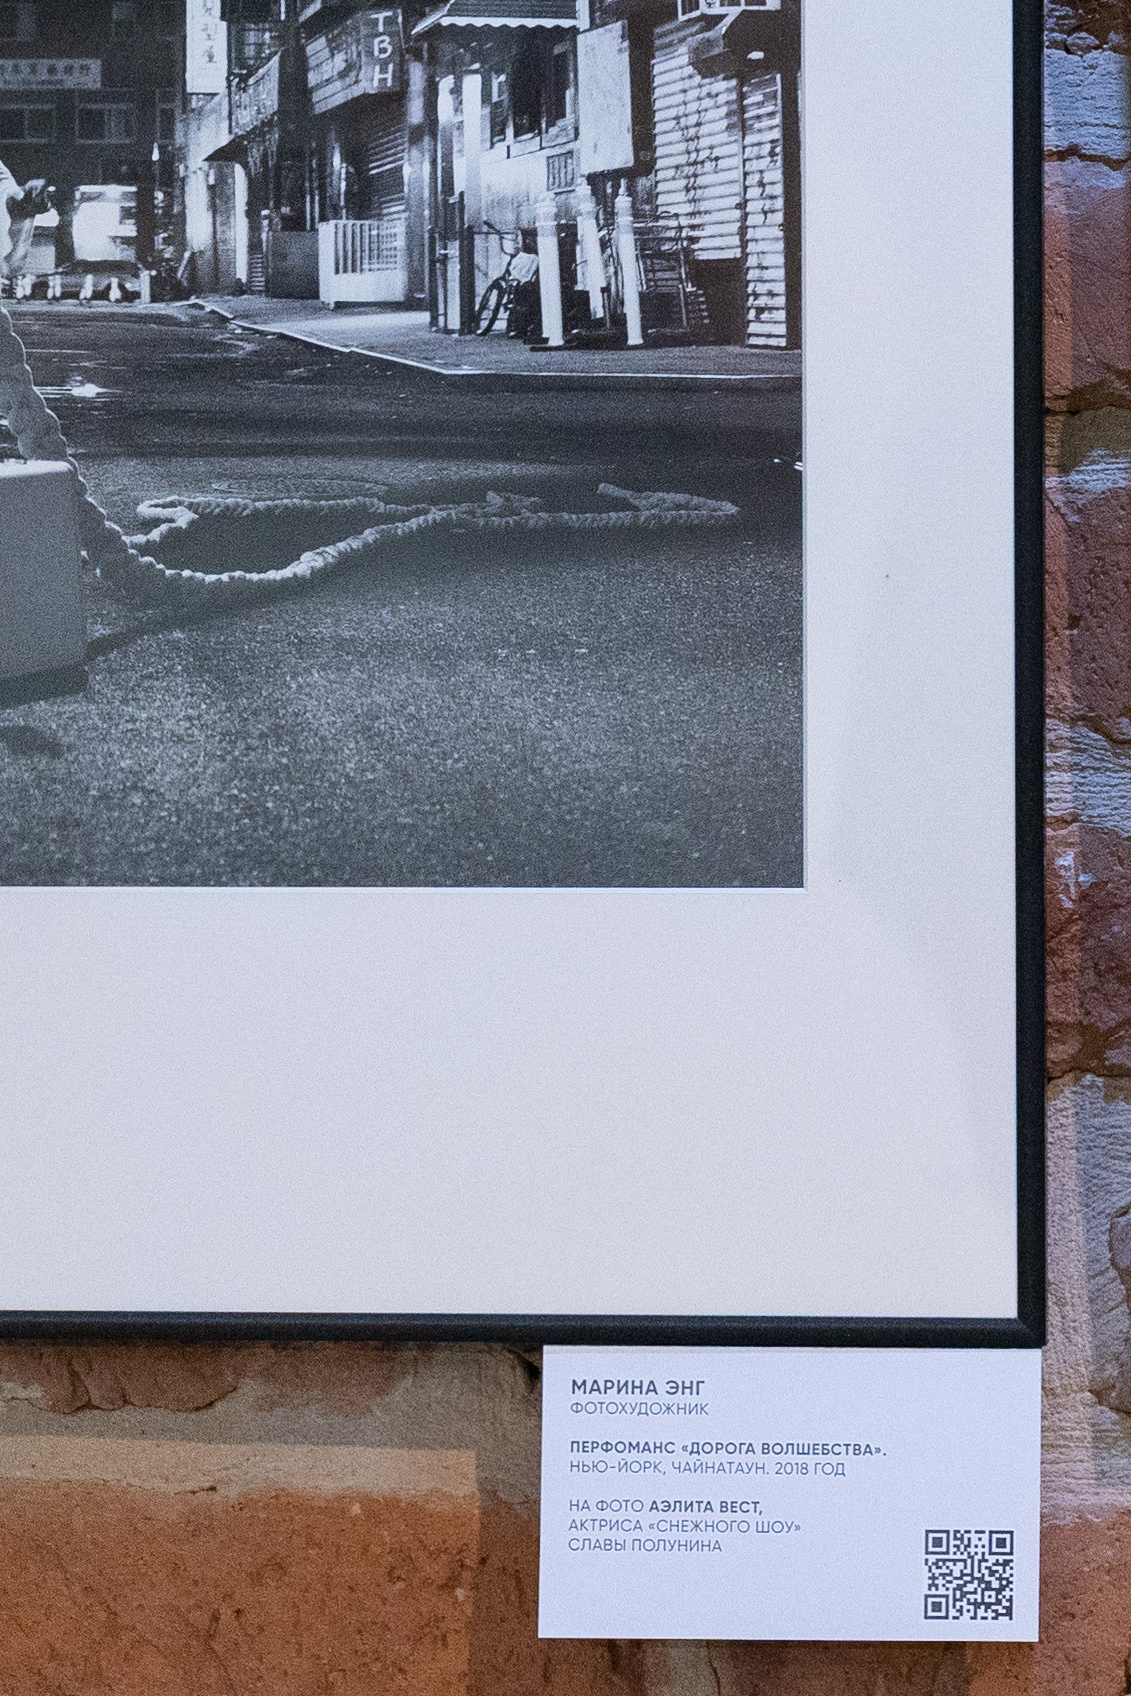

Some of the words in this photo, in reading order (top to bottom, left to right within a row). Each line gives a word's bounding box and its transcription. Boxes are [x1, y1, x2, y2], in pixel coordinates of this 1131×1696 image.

[571, 1379, 659, 1396] МАРИНА
[665, 1380, 706, 1396] ЭНГ
[570, 1401, 709, 1417] ФОТОХУДОЖНИК
[570, 1440, 676, 1455] ПЕРФОМАНС
[682, 1442, 757, 1457] «ДОРОГА
[761, 1442, 887, 1457] ВОЛШЕБСТВА».
[569, 1458, 667, 1476] НЬЮ-ЙОРК,
[671, 1459, 770, 1476] ЧАЙНАТАУН.
[774, 1462, 809, 1477] 2018
[814, 1462, 846, 1478] ГОД
[569, 1499, 591, 1512] НА
[595, 1498, 645, 1513] ФОТО
[649, 1500, 715, 1514] АЭЛИТА
[719, 1500, 763, 1516] ВЕСТ,
[568, 1518, 644, 1533] АКТРИСА
[648, 1519, 751, 1534] «СНЕЖНОГО
[755, 1520, 801, 1534] ШОУ»
[568, 1537, 627, 1552] СЛАВЫ
[631, 1538, 723, 1553] ПОЛУНИНА
